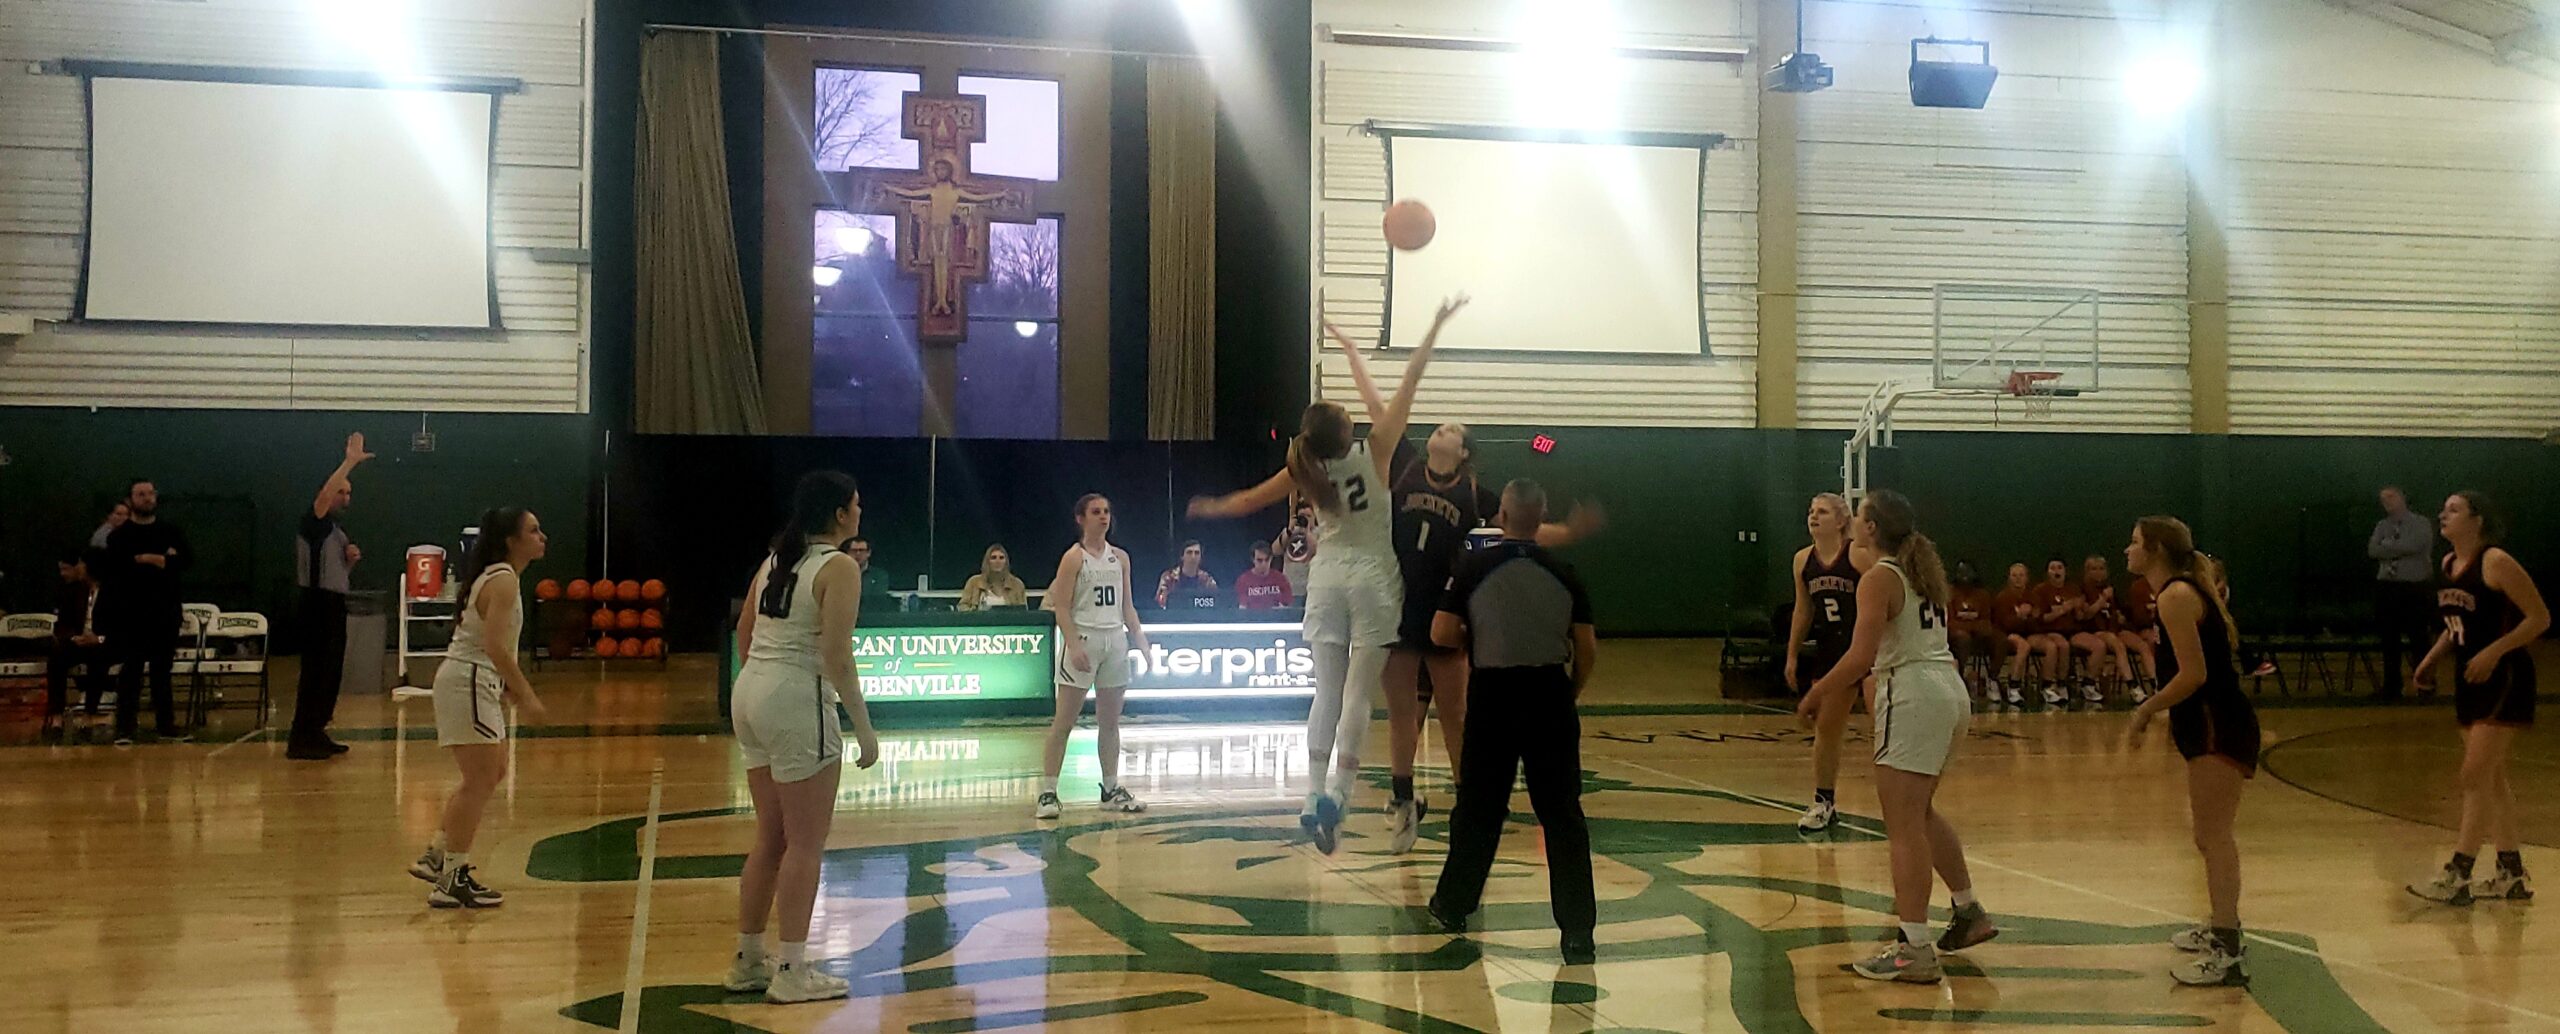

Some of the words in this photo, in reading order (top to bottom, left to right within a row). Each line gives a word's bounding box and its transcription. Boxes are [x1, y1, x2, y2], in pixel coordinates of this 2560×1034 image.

[1533, 435, 1556, 453] EXIT
[1417, 521, 1430, 552] 1
[418, 558, 430, 571] G
[1094, 586, 1116, 606] 30
[1248, 585, 1281, 597] DISCIPLES
[1194, 597, 1214, 607] POSS
[1824, 598, 1841, 622] 2
[851, 635, 897, 656] CAN
[900, 634, 1044, 656] UNIVERSITY
[884, 657, 903, 674] of
